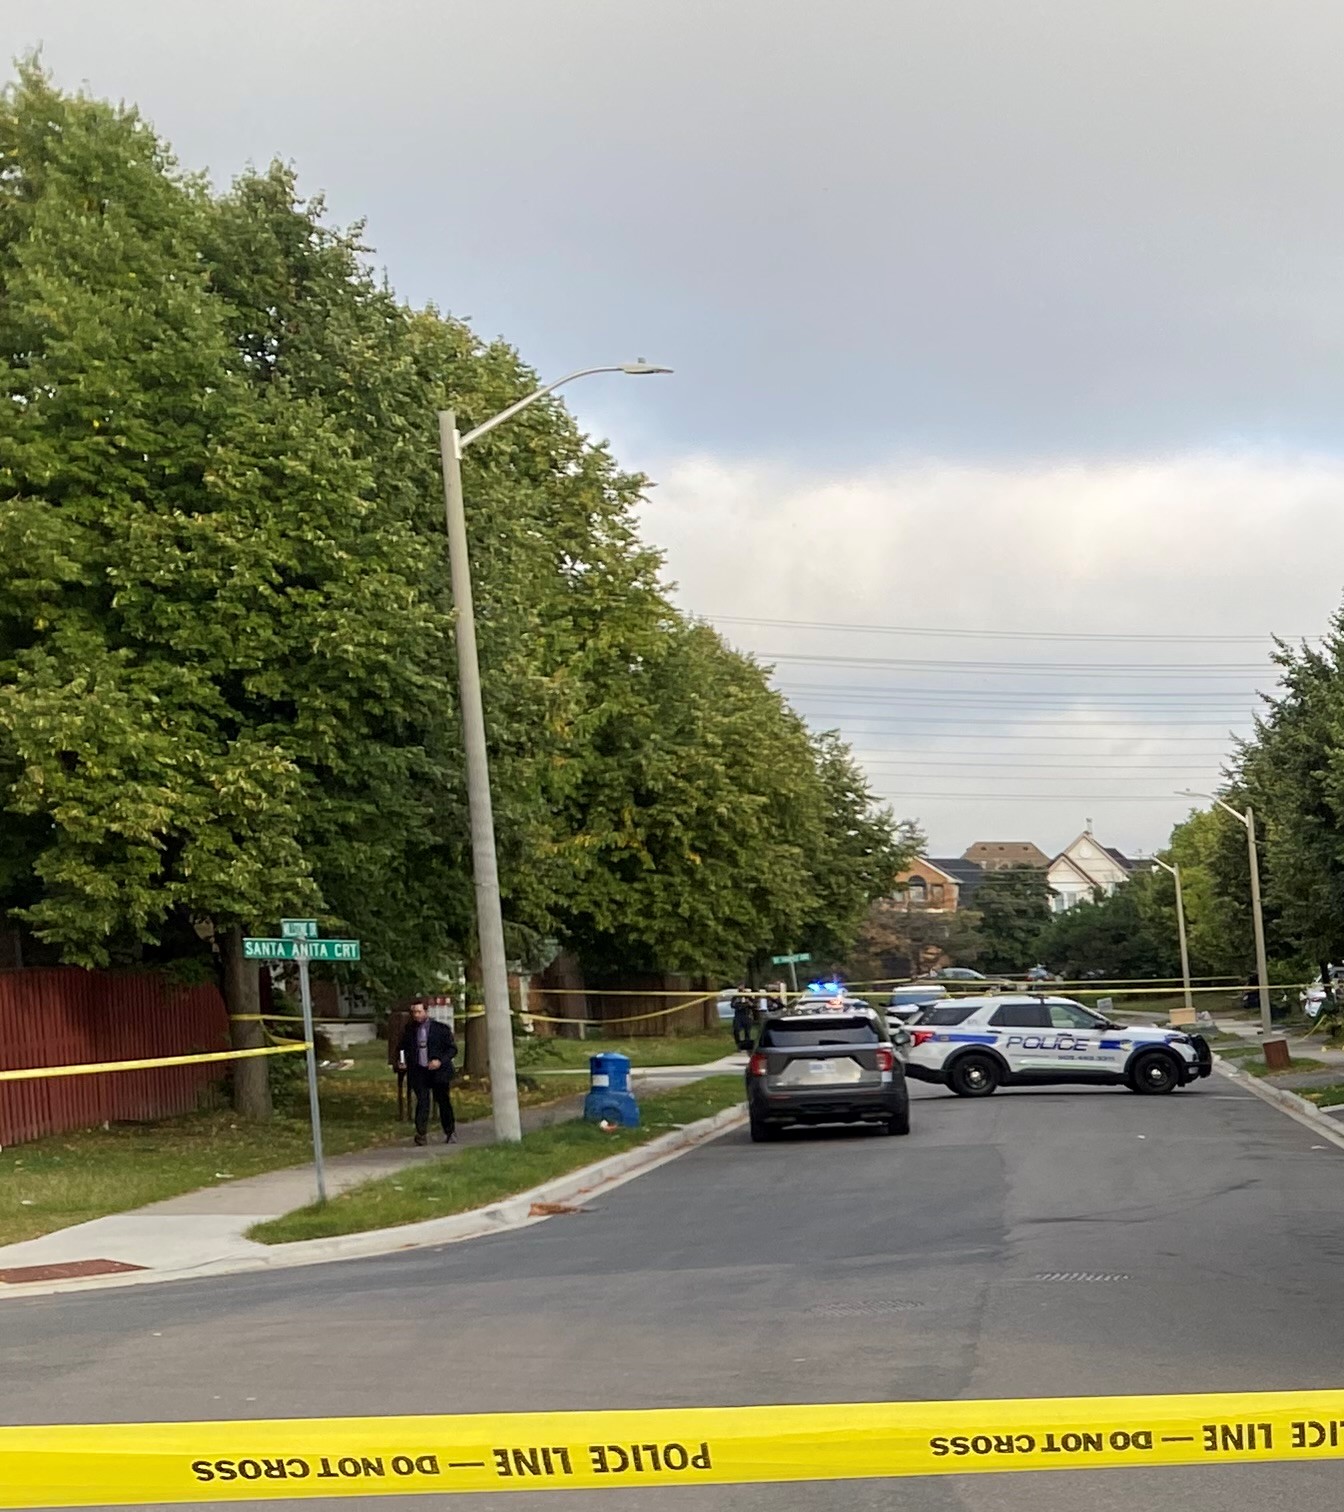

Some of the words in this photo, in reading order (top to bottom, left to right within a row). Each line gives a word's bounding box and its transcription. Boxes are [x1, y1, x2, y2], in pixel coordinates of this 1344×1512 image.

[245, 942, 286, 956] SANTA
[291, 942, 329, 957] ANITA
[334, 943, 357, 957] CRT
[1006, 1036, 1090, 1051] POLICE
[928, 1434, 1036, 1457] CROSS
[1041, 1432, 1103, 1453] NOT
[1109, 1430, 1153, 1451] DO
[1203, 1423, 1273, 1452] LINE
[317, 1457, 385, 1478] NOT
[392, 1455, 438, 1476] DO
[494, 1447, 573, 1478] LINE
[593, 1442, 712, 1475] POLICE
[191, 1458, 310, 1482] CROSS
